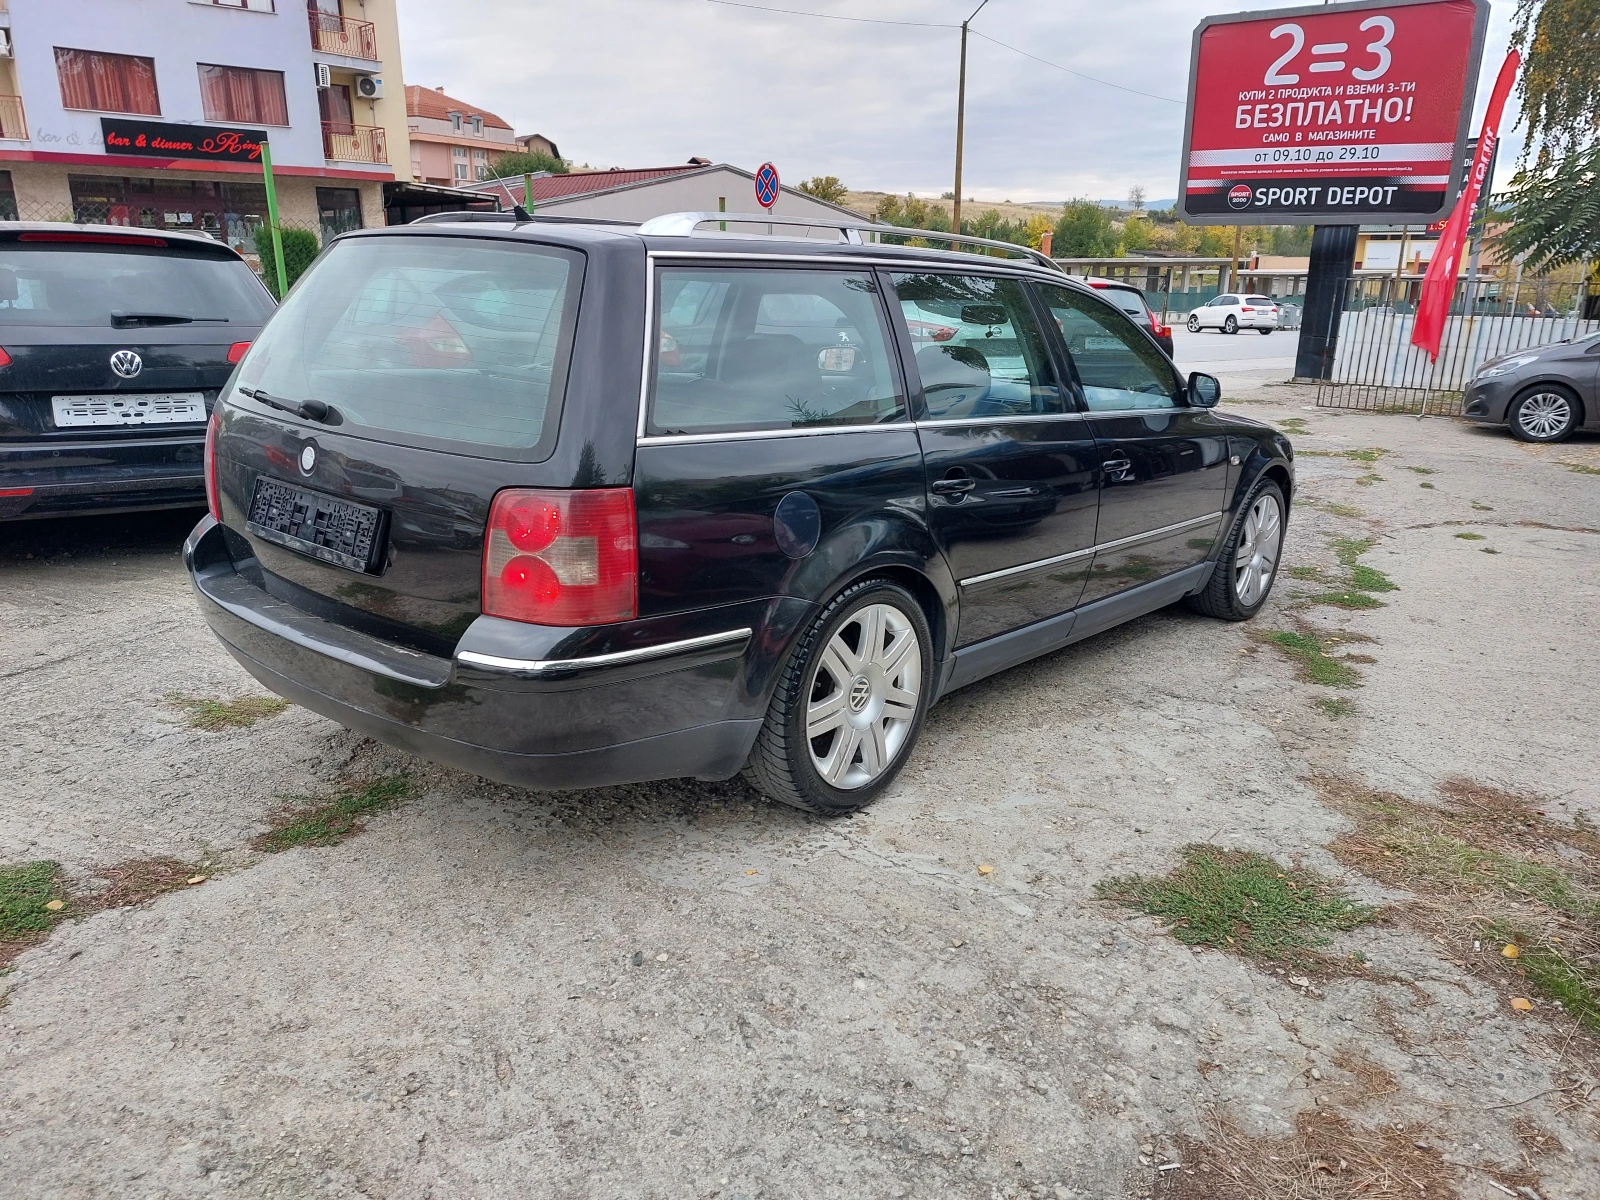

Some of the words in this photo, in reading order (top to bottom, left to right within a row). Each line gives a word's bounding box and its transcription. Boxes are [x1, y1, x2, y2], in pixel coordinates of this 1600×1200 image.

[1263, 15, 1395, 86] 2=3
[1238, 90, 1265, 101] КУПИ
[1268, 89, 1275, 100] 2
[1277, 86, 1332, 100] ПРОДУКТА
[1335, 85, 1344, 96] И
[1346, 83, 1384, 95] ВЗЕМИ
[1386, 82, 1416, 93] 3-ТИ
[1235, 96, 1414, 129] БЕЗПЛАТНО!
[107, 132, 130, 146] bar
[135, 133, 147, 148] &
[151, 137, 193, 150] dinner
[197, 131, 262, 159] Ring
[1262, 132, 1290, 143] САМО
[1295, 132, 1303, 142] В
[1308, 129, 1377, 141] МАГАЗИНИТЕ
[1254, 152, 1269, 162] от
[1273, 148, 1312, 161] 09.10
[1315, 150, 1334, 163] до
[1338, 146, 1380, 160] 29.10
[1254, 186, 1321, 206] SPORT
[1326, 185, 1399, 205] DEPOT
